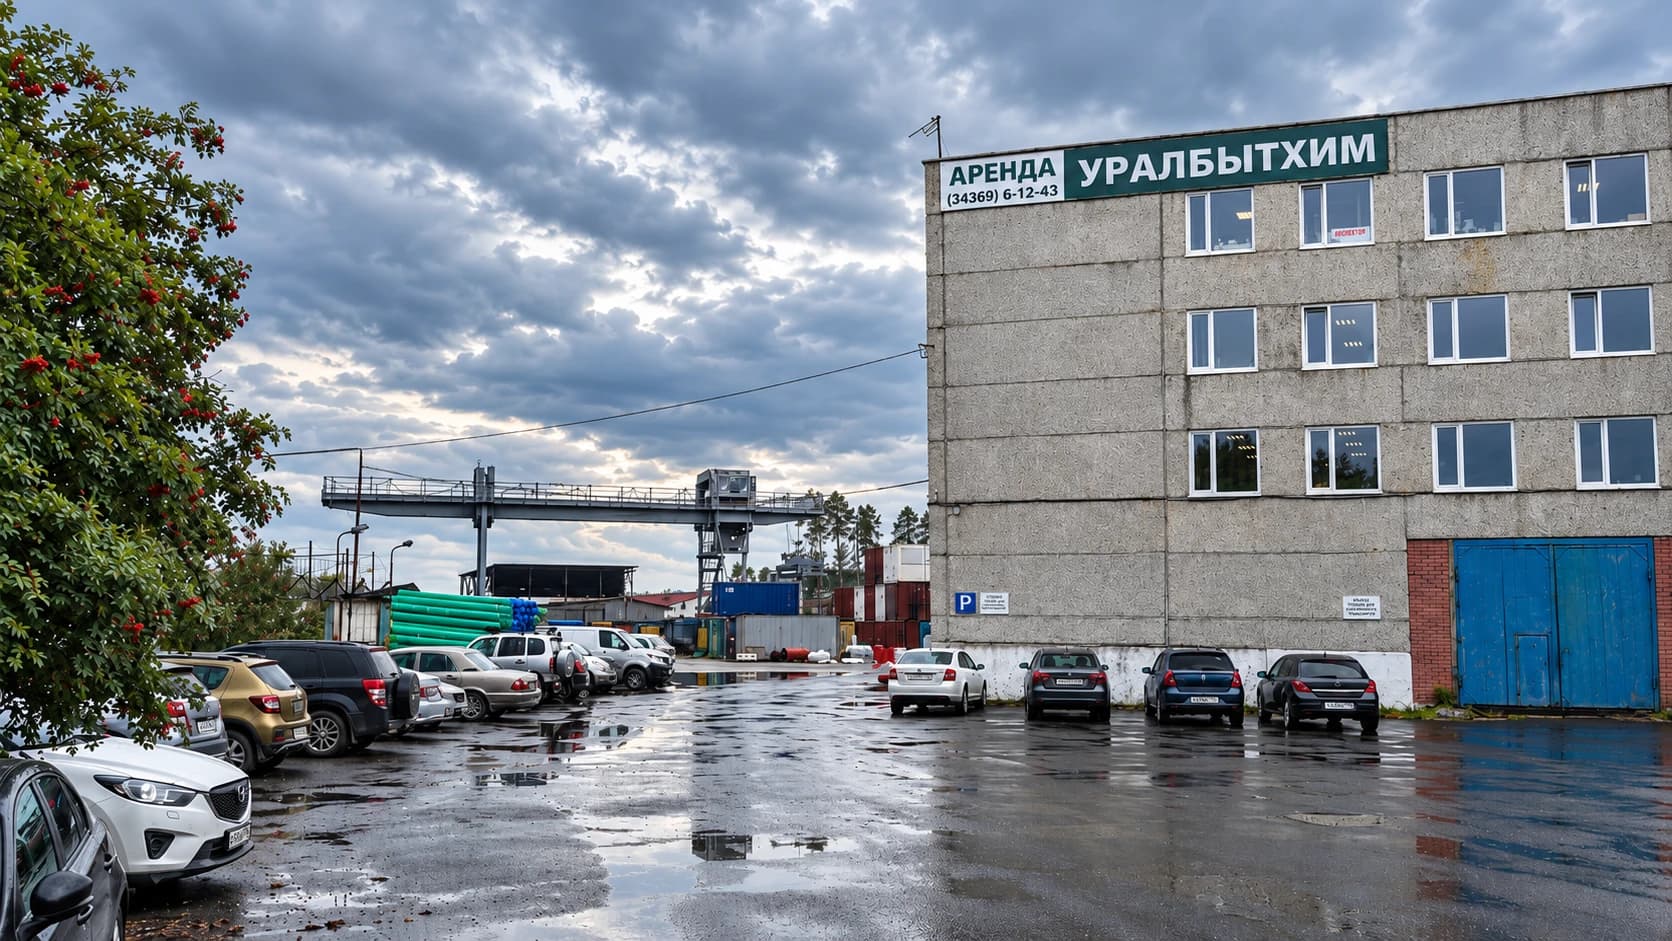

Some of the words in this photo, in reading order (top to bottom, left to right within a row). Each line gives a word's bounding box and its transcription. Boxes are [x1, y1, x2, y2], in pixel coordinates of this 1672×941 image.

[949, 157, 1057, 187] АРЕНДА
[1078, 133, 1376, 188] УРАЛБЫТХИМ
[947, 189, 999, 207] (34369)
[1003, 184, 1059, 201] 6-12-43
[960, 594, 972, 611] P
